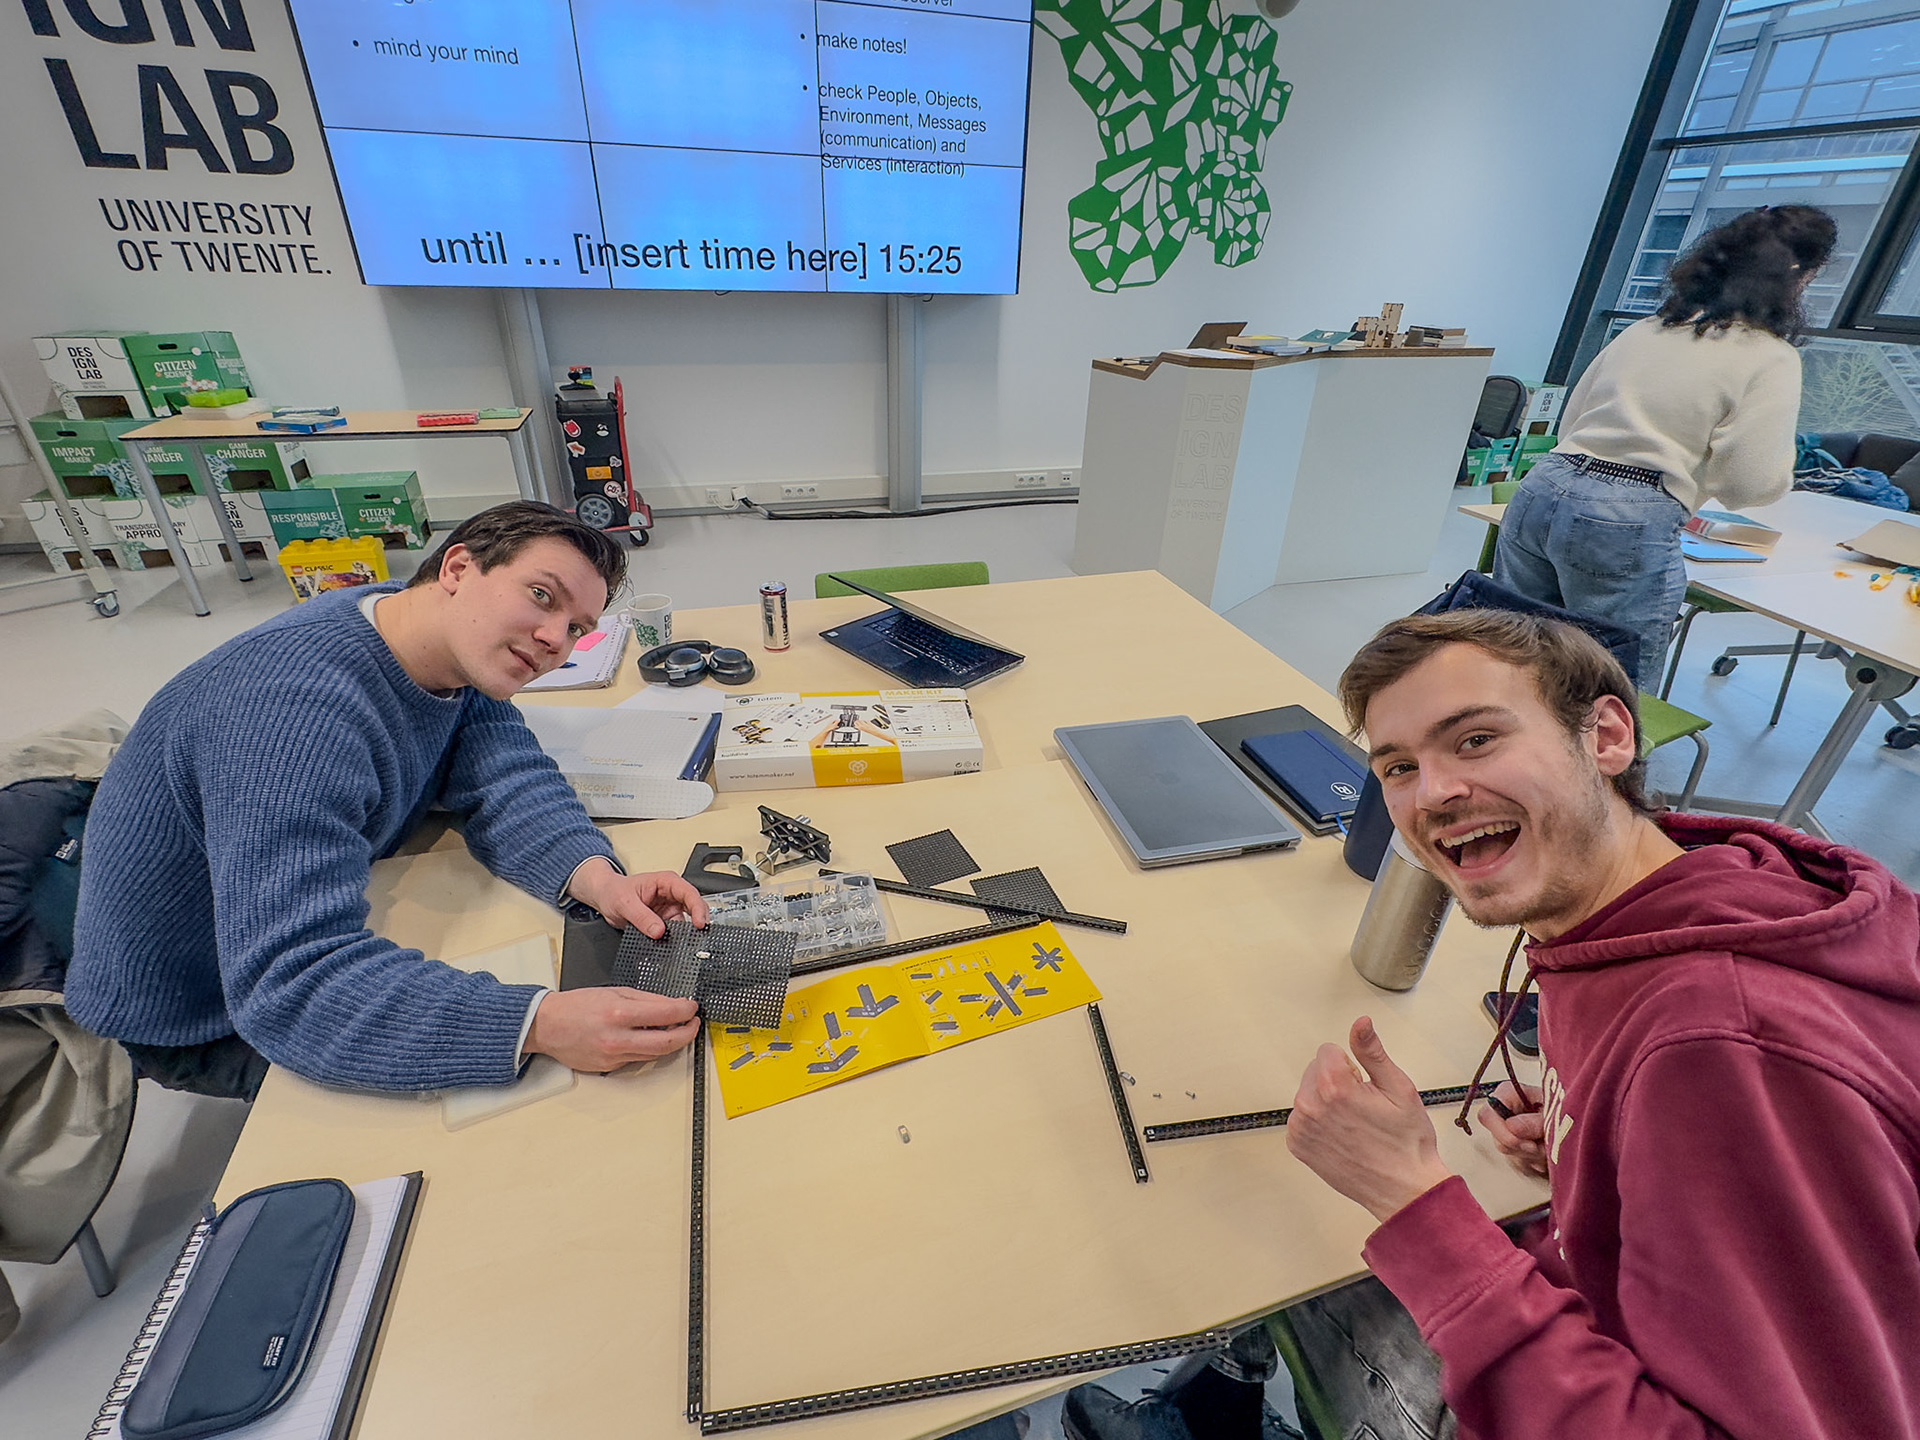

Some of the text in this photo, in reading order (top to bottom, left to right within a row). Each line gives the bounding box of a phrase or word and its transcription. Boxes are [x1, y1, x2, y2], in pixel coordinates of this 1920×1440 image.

[374, 37, 519, 65] mind your mind
[817, 33, 907, 54] make notes!
[818, 83, 982, 111] check People, Objects,
[43, 57, 295, 175] LAB
[820, 105, 987, 135] Environment, Messages
[820, 130, 966, 155] (communication) and
[821, 153, 965, 178] Services (interaction)
[98, 198, 312, 236] UNIVERSITY
[117, 240, 332, 275] OF TWENTE.
[421, 231, 962, 280] until ... [insert time here] 15:25
[67, 346, 93, 358] DES
[71, 357, 98, 369] IGN
[76, 369, 103, 380] LAB
[153, 360, 198, 372] CITIZEN
[1185, 393, 1242, 424] DES
[52, 447, 95, 458] IMPACT
[217, 449, 267, 459] CHANGER
[228, 442, 249, 450] GAME
[1178, 429, 1235, 459] IGN
[1174, 462, 1230, 490] LAB
[271, 511, 338, 523] RESPONSIBLE
[295, 520, 320, 528] DESIGN
[359, 507, 396, 518] CITIZEN
